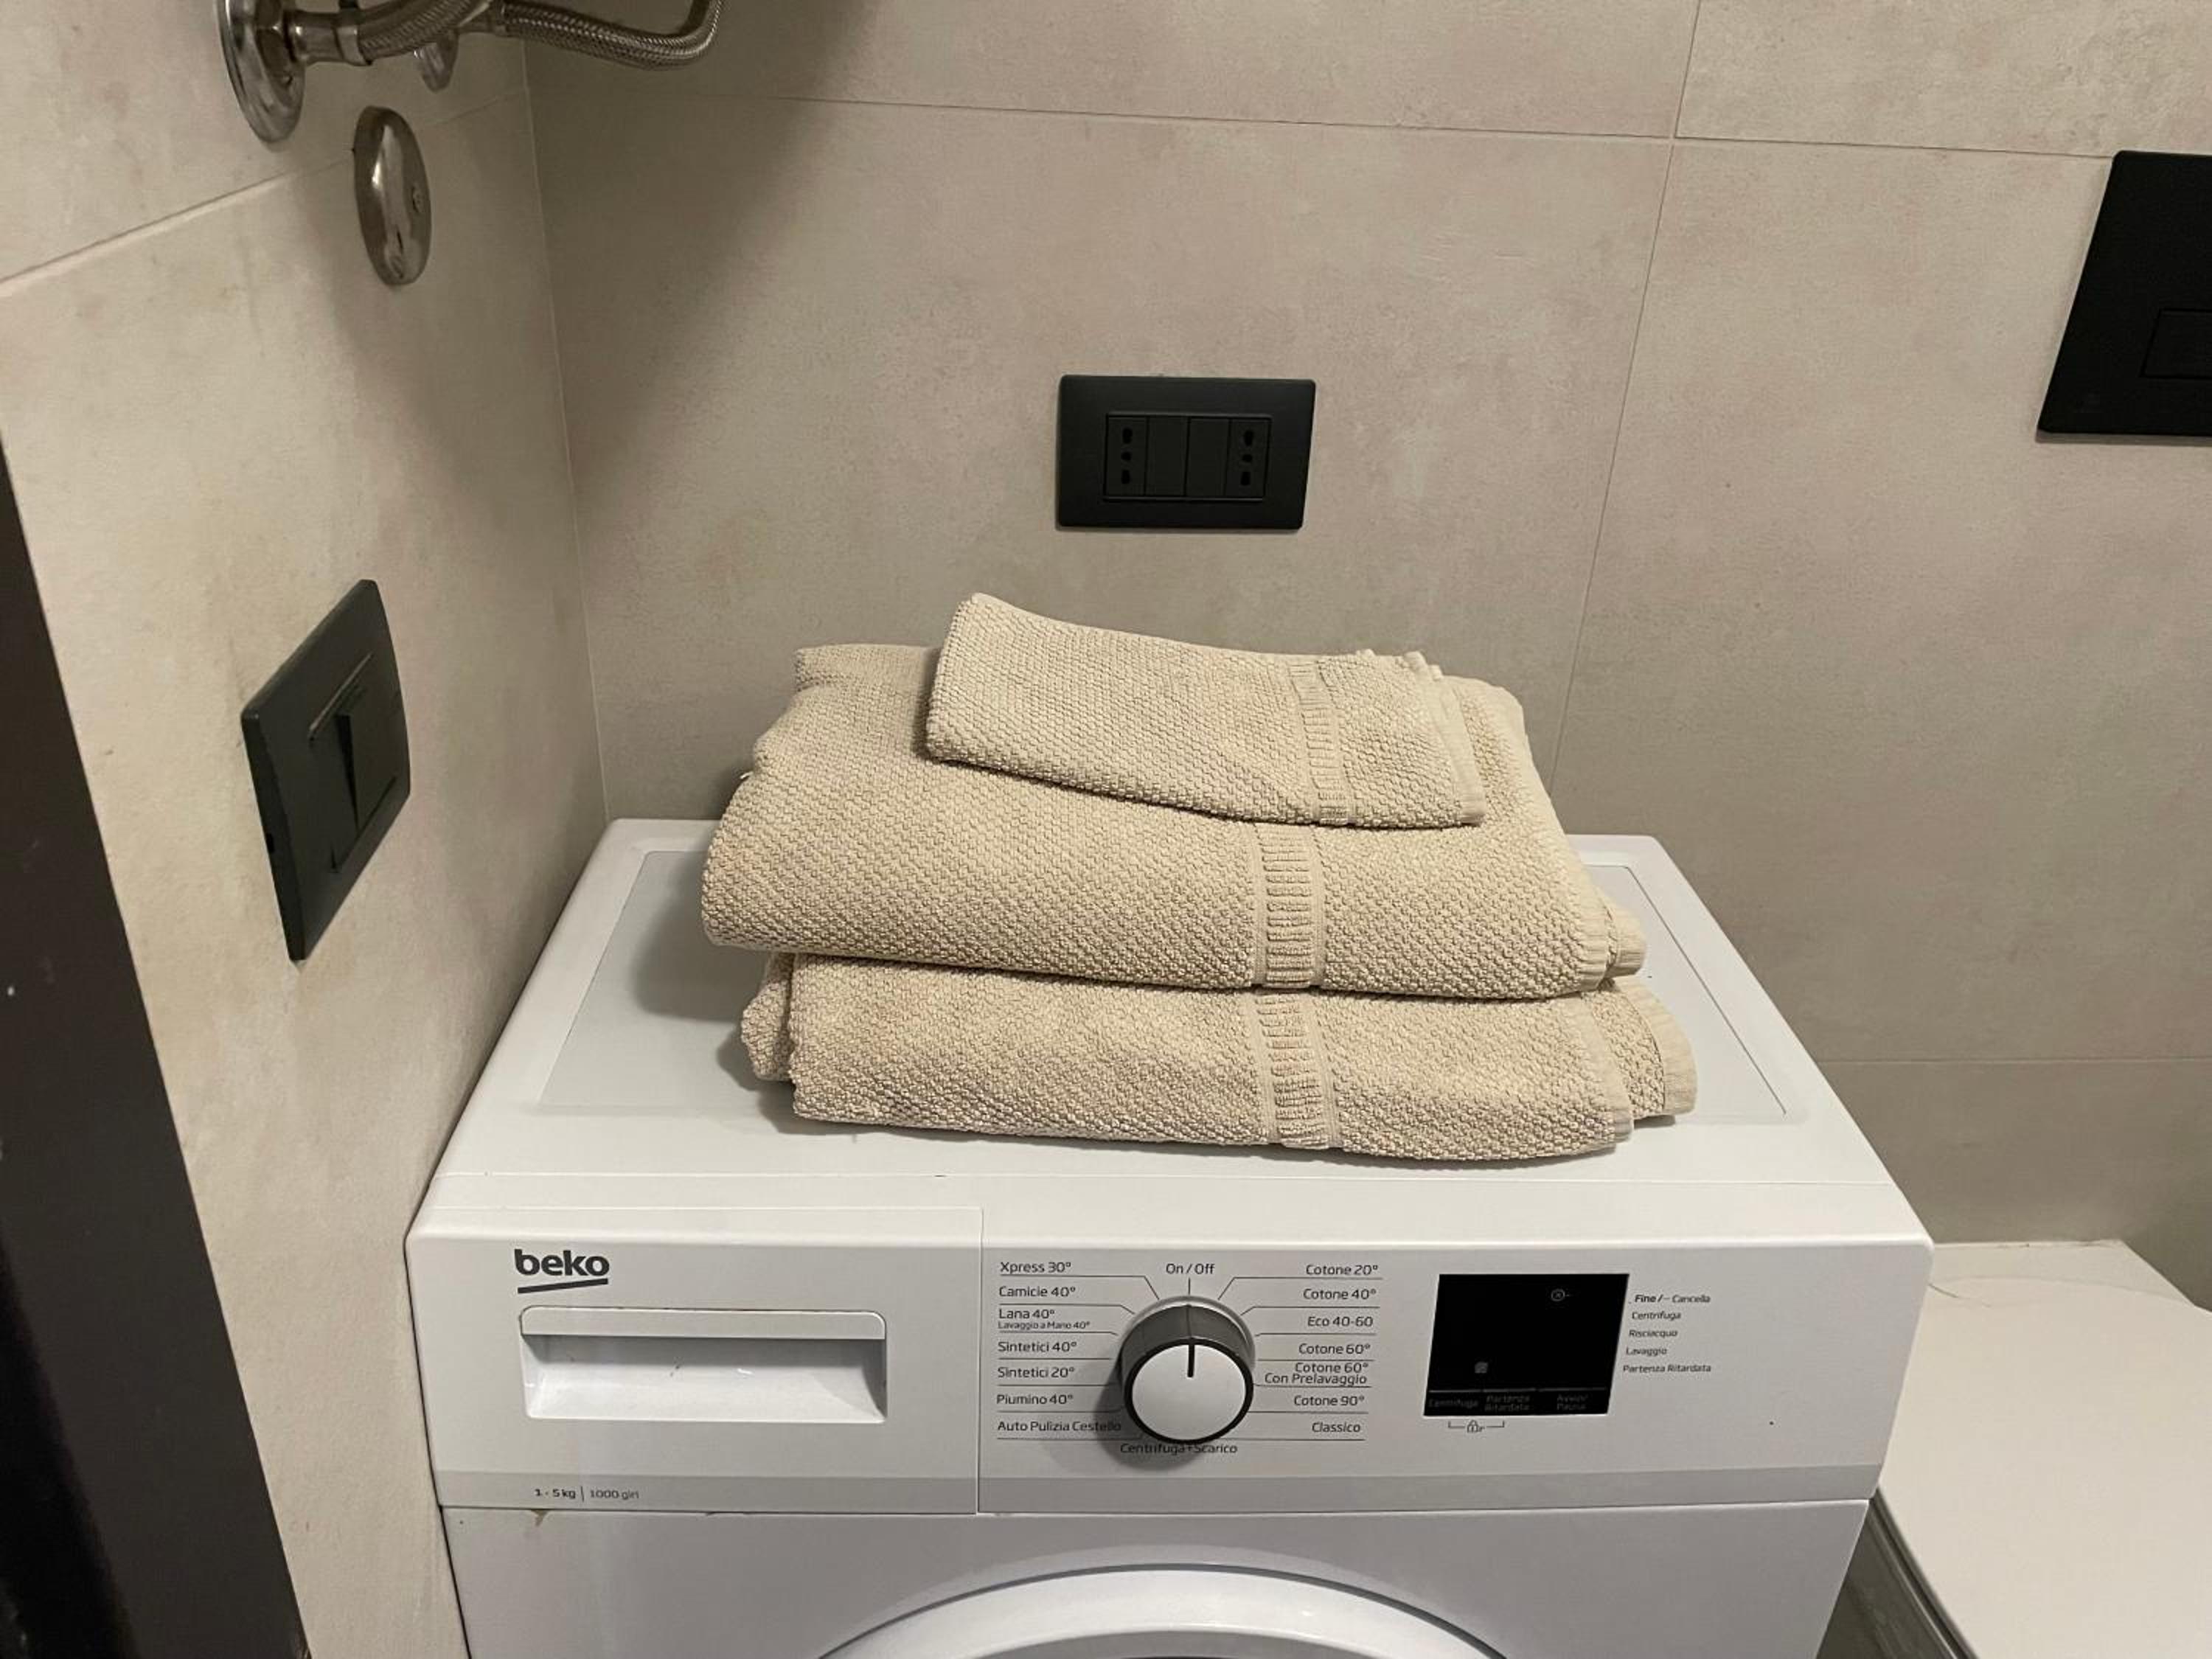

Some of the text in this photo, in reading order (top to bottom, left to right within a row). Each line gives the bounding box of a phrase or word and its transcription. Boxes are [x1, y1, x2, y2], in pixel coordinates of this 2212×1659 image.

[514, 1248, 610, 1276] beko
[1000, 1262, 1072, 1274] Xpress 30°
[1165, 1264, 1183, 1275] On
[1194, 1263, 1216, 1275] Off
[1305, 1265, 1379, 1276] Cotone 20°
[998, 1287, 1076, 1298] Camicie 40°
[1303, 1288, 1377, 1300] Cotone 40°
[1635, 1294, 1657, 1303] Fine
[998, 1309, 1055, 1320] Lana 40°
[1631, 1311, 1681, 1321] Centrifuga
[998, 1321, 1039, 1330] Lavaggio
[1307, 1316, 1374, 1326] Eco 40-60
[1629, 1329, 1678, 1339] Risciacquo
[998, 1341, 1077, 1353] Sintetici 40°
[1298, 1343, 1371, 1354] Cotone 60°
[1625, 1348, 1668, 1357] Lavaggio
[998, 1367, 1075, 1378] Sintetici 20°
[1295, 1362, 1369, 1373] Cotone 60°
[1622, 1364, 1711, 1374] Partenza Ritardata
[1265, 1372, 1367, 1387] Con Prelavaggio
[996, 1394, 1074, 1405] Piumino 40°
[1293, 1395, 1365, 1406] Cotone 90°
[997, 1422, 1121, 1432] Auto Pulizia Cestello
[1311, 1422, 1361, 1433] Classico
[590, 1489, 619, 1499] 1000
